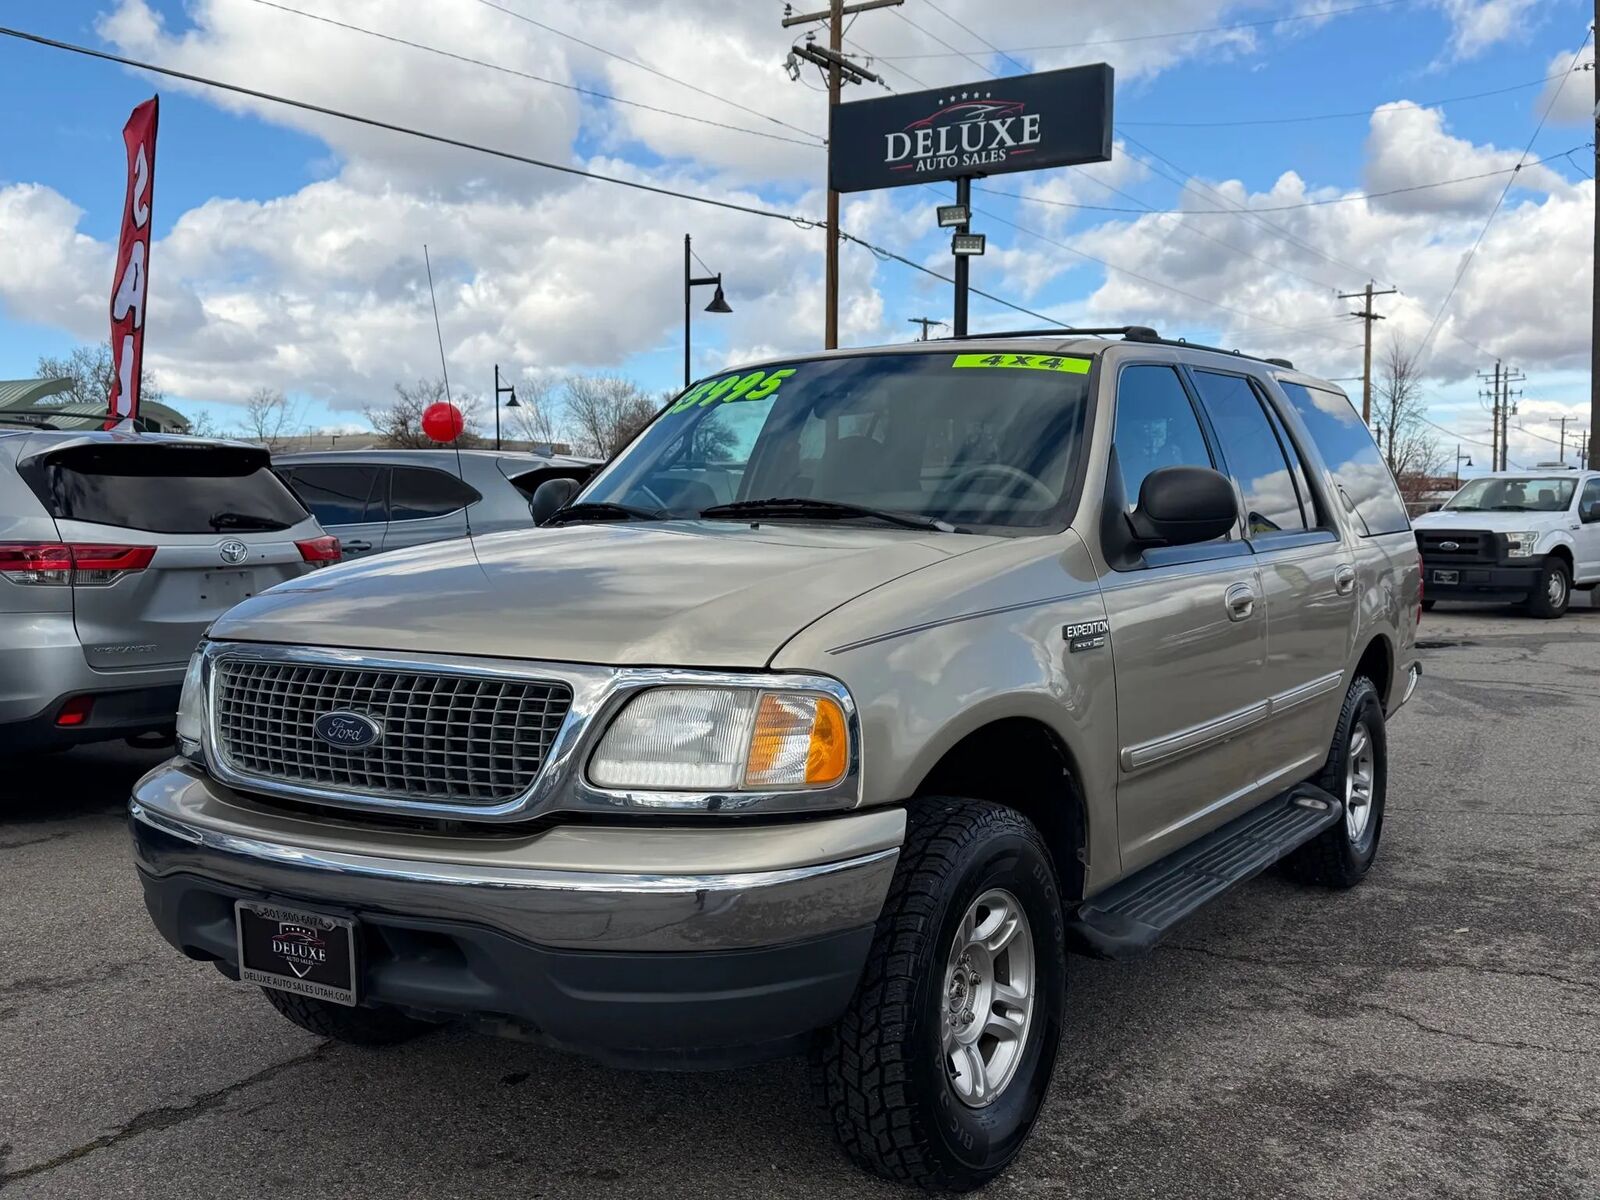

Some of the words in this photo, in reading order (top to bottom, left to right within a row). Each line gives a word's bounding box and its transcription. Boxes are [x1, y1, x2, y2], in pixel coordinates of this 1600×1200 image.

[884, 113, 1042, 162] DELUXE
[916, 155, 959, 172] AUTO
[962, 149, 1007, 166] SALES
[1067, 620, 1109, 638] EXPEDITION
[327, 717, 364, 741] Ford
[272, 939, 326, 962] DELUXE
[243, 970, 272, 985] DELUXE
[272, 977, 292, 989] AUTO
[292, 982, 314, 995] SALES
[315, 987, 352, 1003] UTAH.COM
